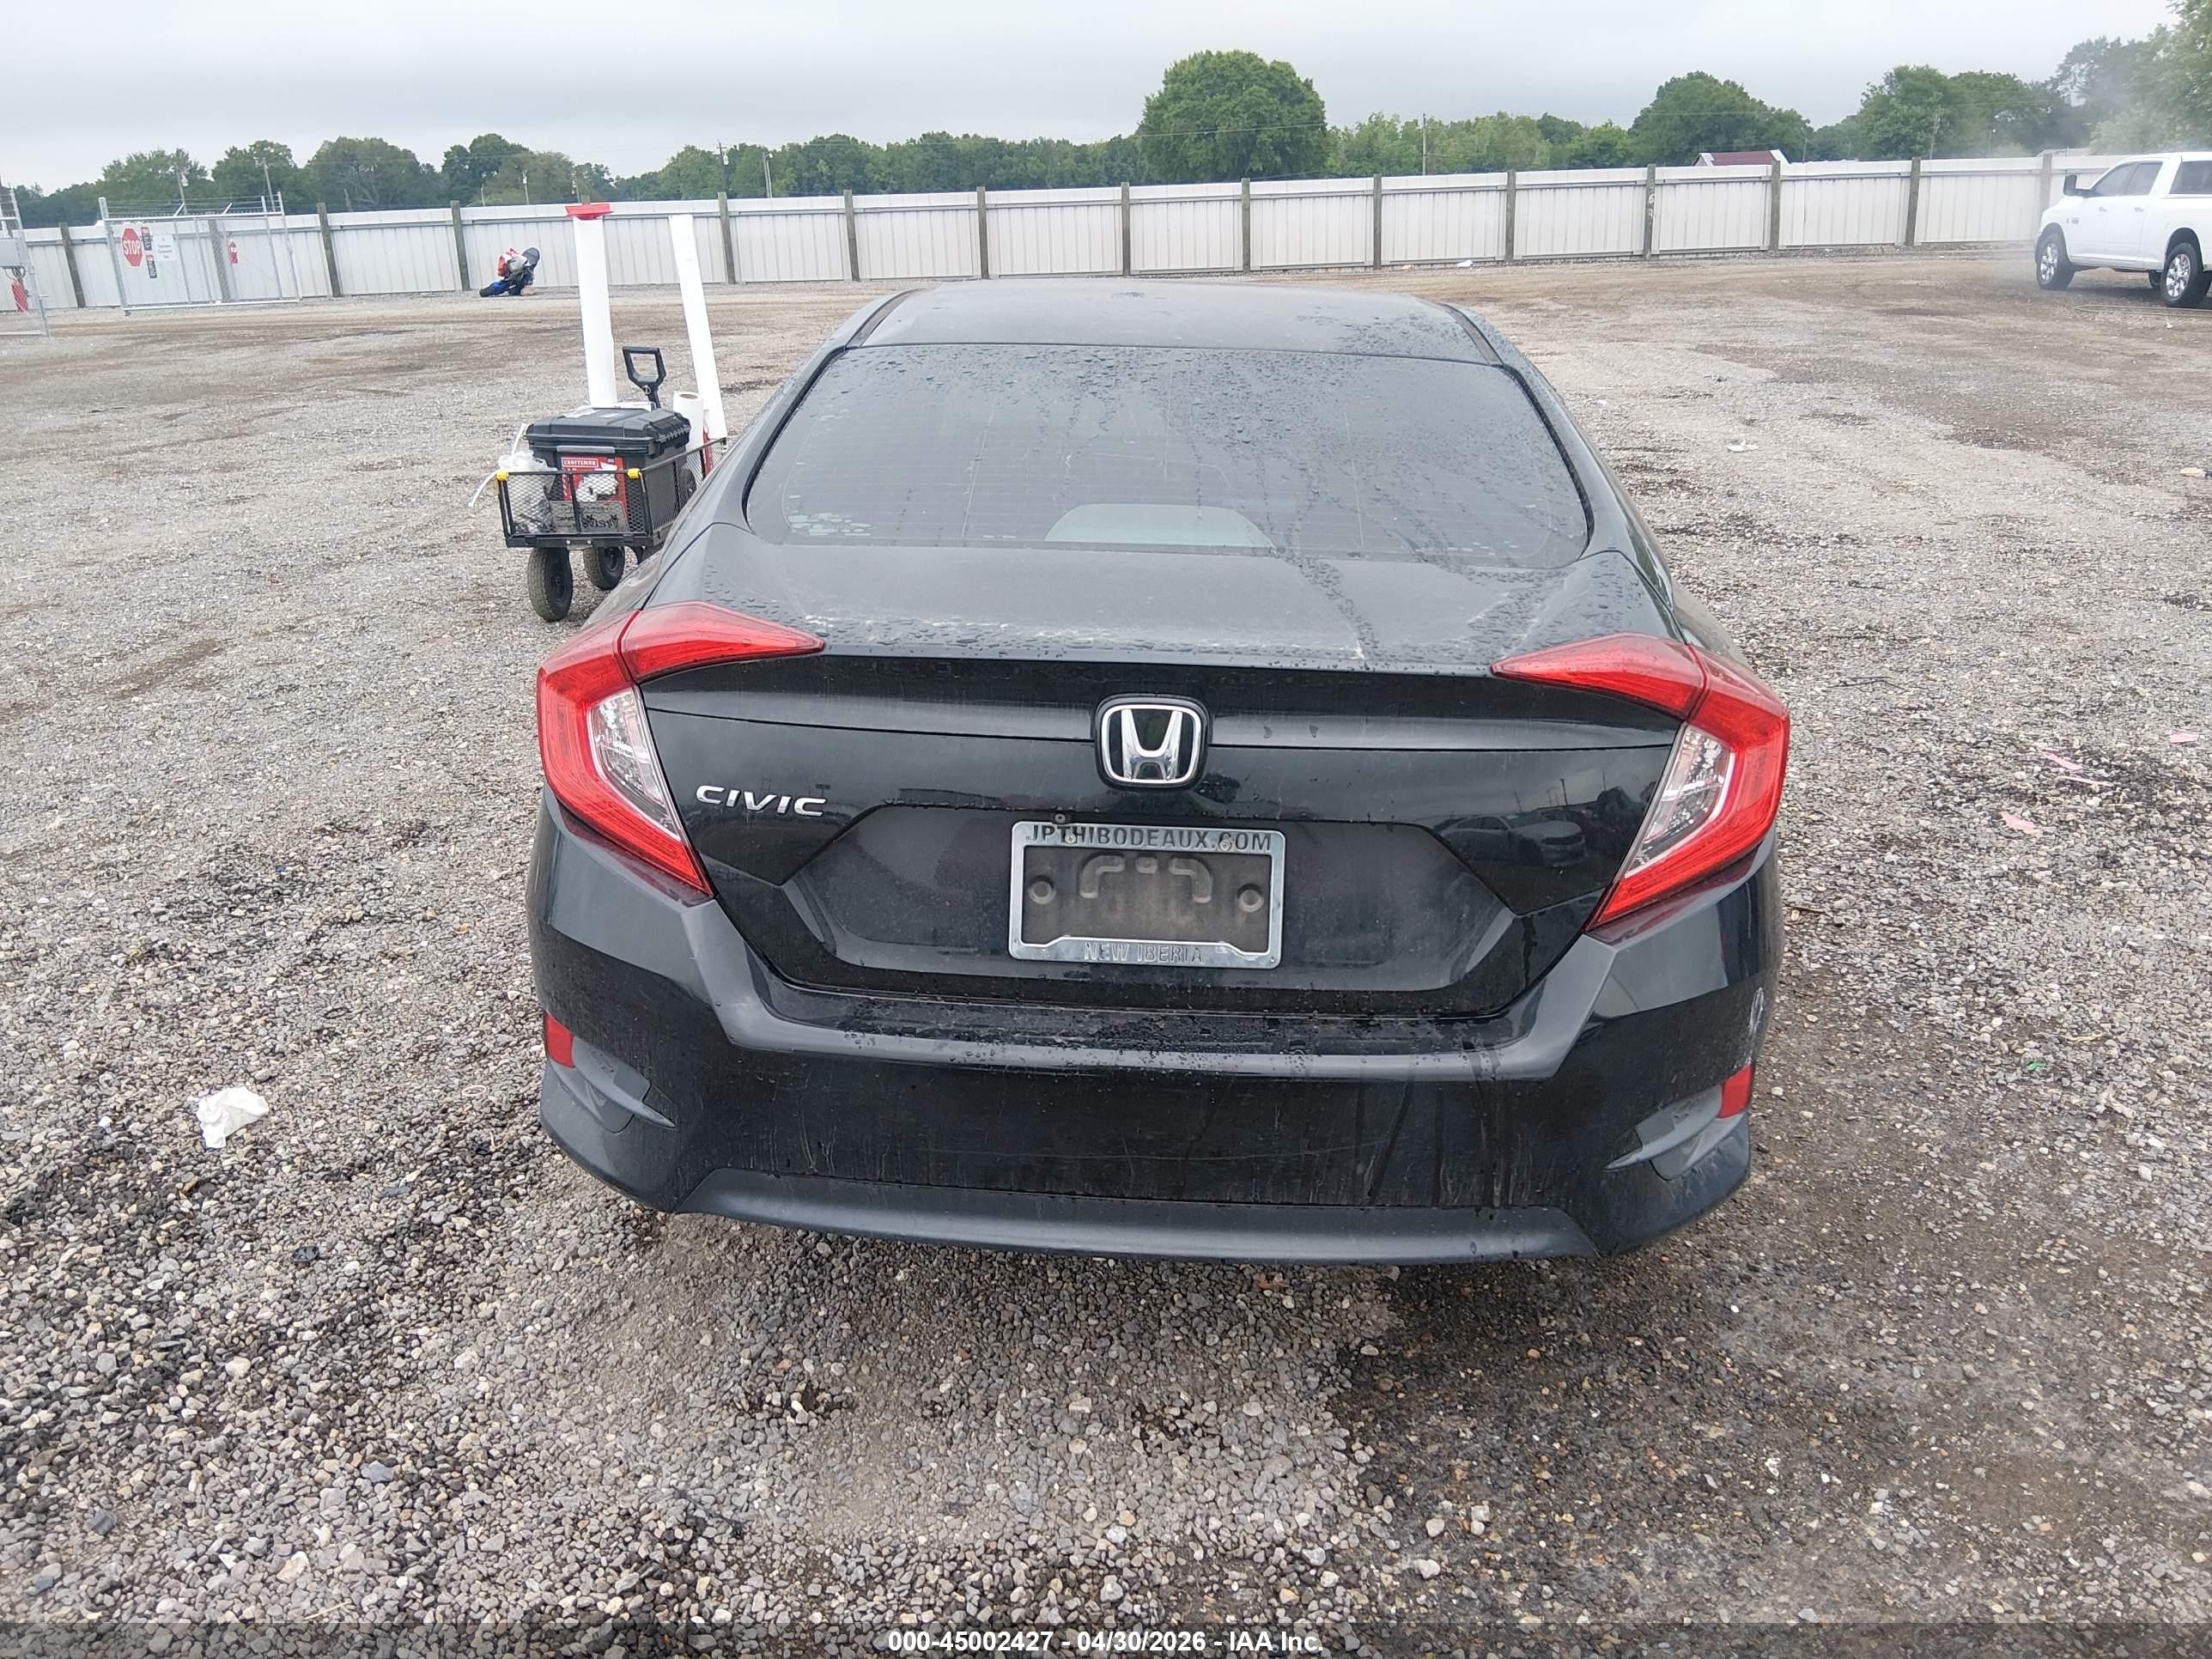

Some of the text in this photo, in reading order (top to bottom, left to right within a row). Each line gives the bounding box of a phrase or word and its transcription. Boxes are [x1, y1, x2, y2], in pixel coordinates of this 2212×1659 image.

[123, 240, 141, 255] STOP
[696, 784, 827, 817] CIVIC
[1032, 824, 1272, 851] JPTHIBODEAUX.COM
[1085, 942, 1203, 963] NEW IBERIA
